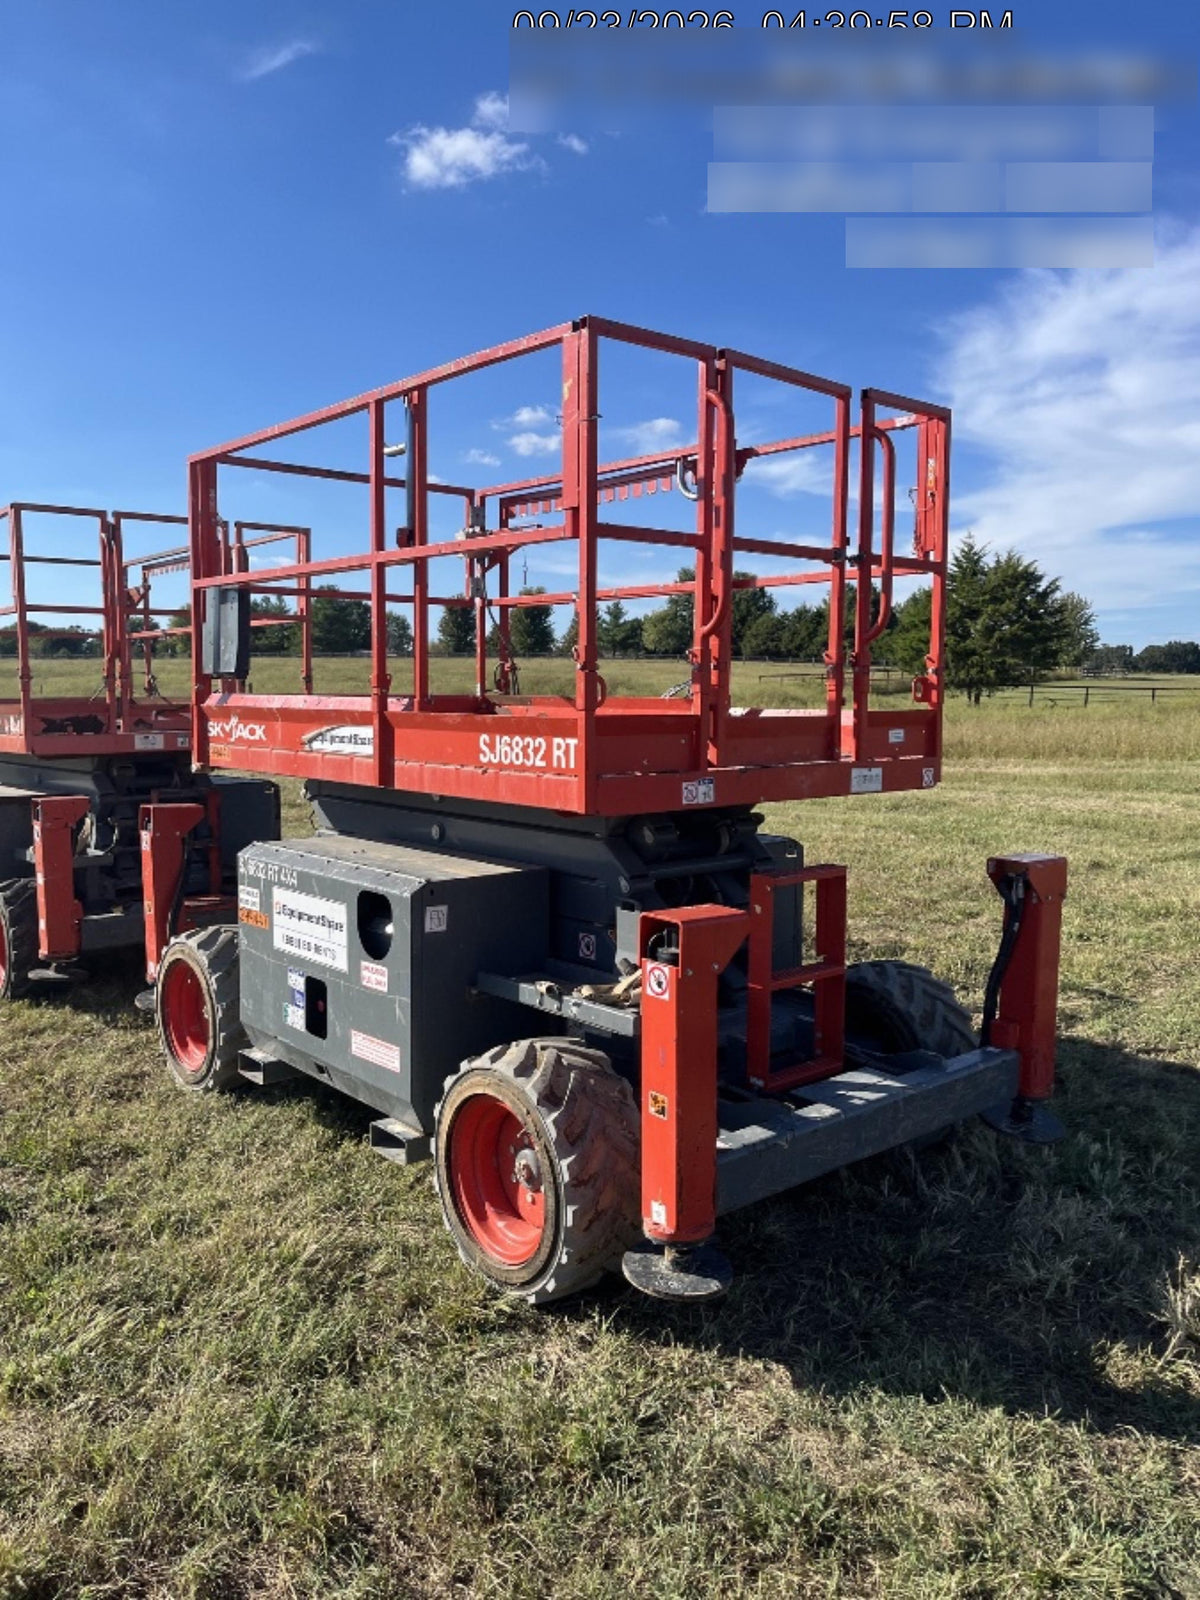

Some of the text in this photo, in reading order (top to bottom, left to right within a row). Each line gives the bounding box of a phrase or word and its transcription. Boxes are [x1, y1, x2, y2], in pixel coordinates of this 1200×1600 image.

[208, 714, 267, 742] SKYJACK
[479, 733, 578, 769] SJ6832 RT
